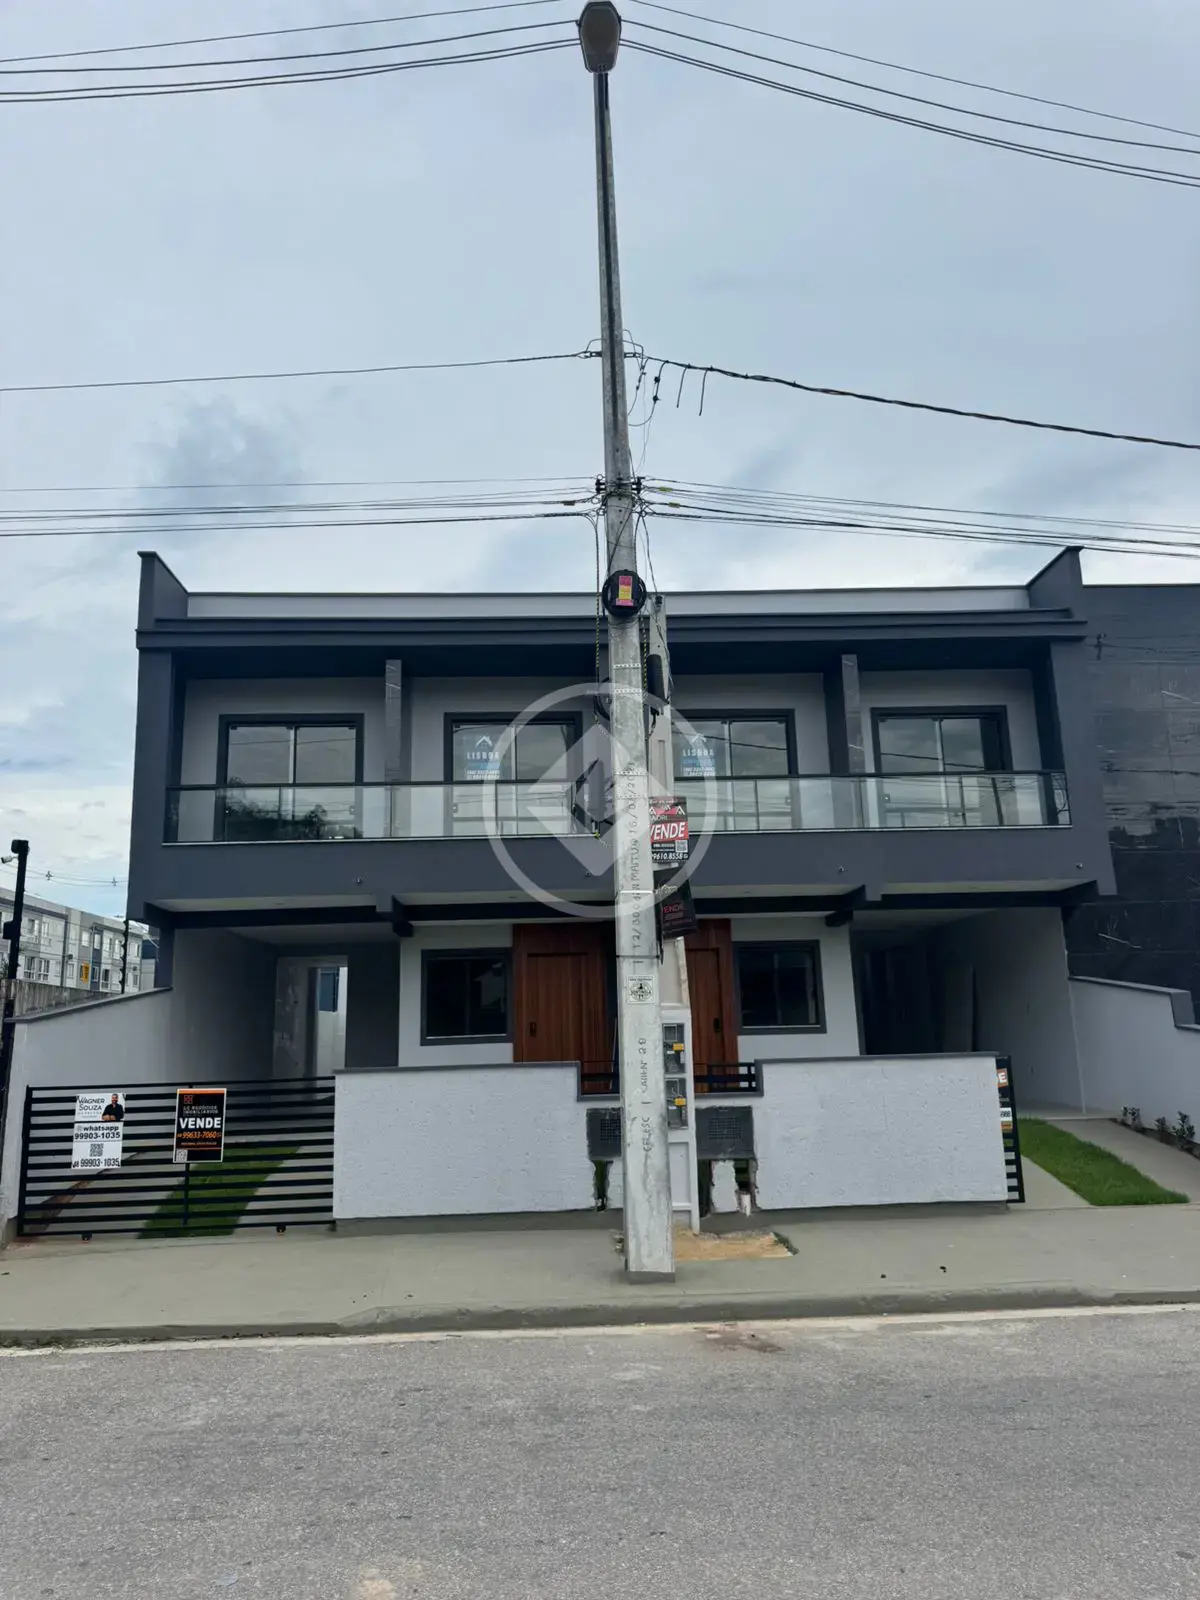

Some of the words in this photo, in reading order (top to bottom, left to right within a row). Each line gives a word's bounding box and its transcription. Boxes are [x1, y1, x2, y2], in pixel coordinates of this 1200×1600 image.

[78, 1096, 105, 1105] WAGNER
[179, 1117, 222, 1129] VENDE
[74, 1131, 121, 1140] 99903-1035
